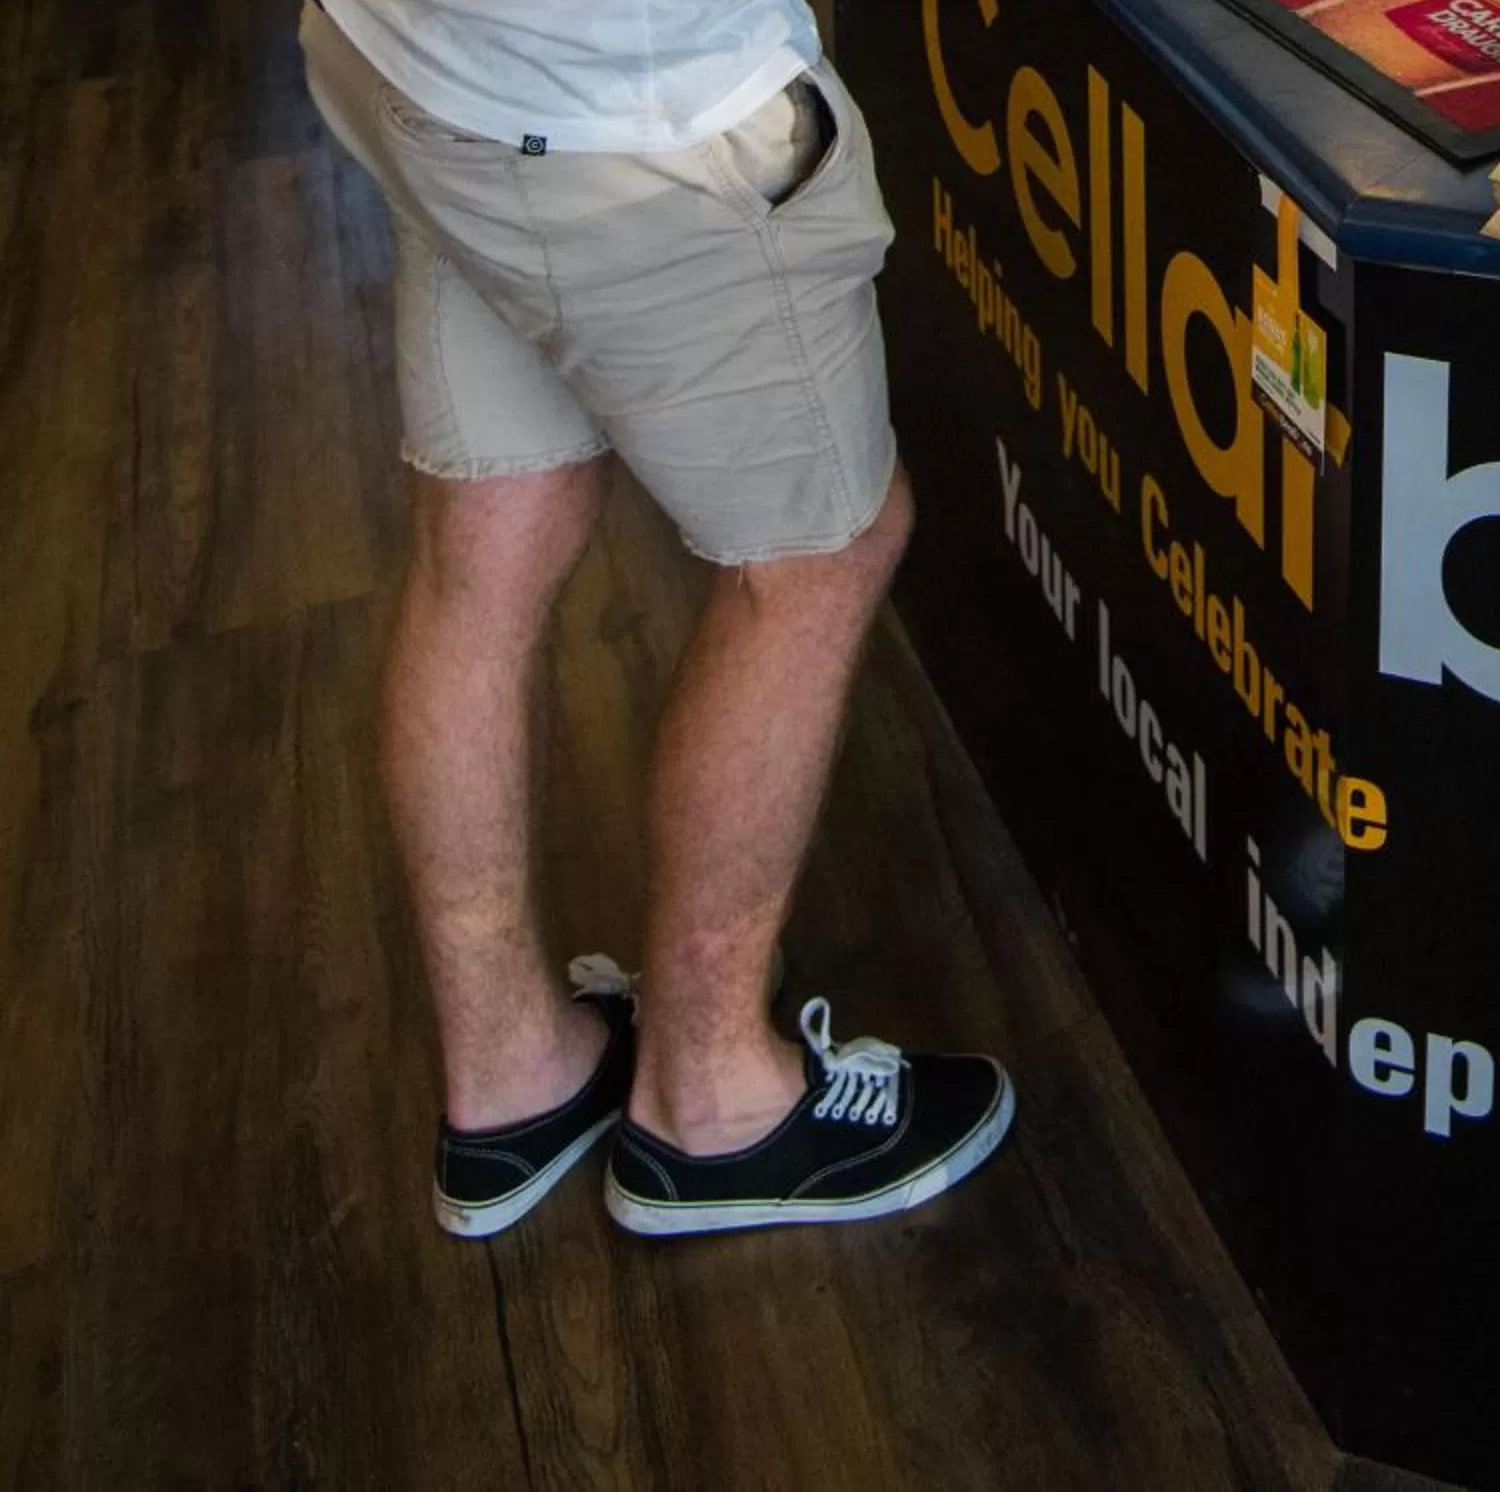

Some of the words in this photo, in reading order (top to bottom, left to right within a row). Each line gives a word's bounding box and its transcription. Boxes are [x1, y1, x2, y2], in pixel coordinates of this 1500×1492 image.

[931, 175, 1043, 412] Helping
[1056, 369, 1122, 516] you
[1141, 473, 1388, 852] Celebrate
[995, 434, 1082, 643] Your
[1099, 597, 1207, 863] local
